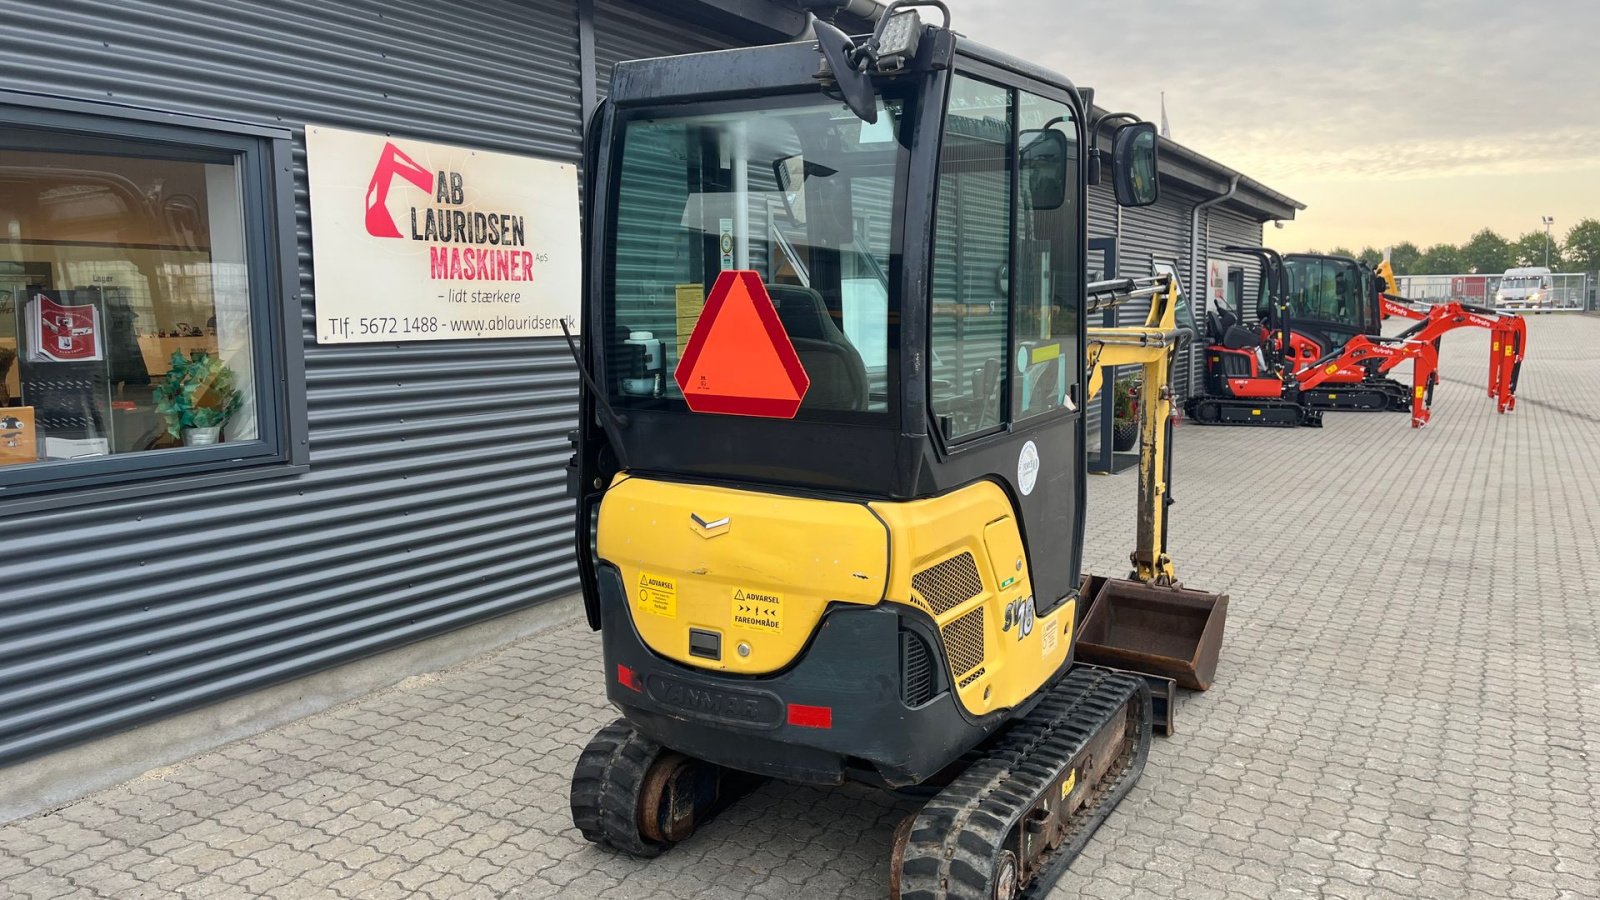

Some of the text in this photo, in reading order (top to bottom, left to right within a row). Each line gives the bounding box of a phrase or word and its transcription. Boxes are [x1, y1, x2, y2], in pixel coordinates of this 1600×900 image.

[437, 170, 464, 205] AB
[411, 206, 525, 247] LAURIDSEN
[430, 246, 549, 281] MASKINER ApS
[448, 288, 468, 303] lidt
[471, 289, 521, 303] stærkere
[1384, 302, 1408, 317] Kubota
[328, 317, 354, 339] Tlf.
[360, 317, 398, 335] 5672
[403, 316, 438, 333] 1488
[648, 578, 674, 590] ADVARSEL
[746, 593, 780, 604] ADVARSEL
[734, 615, 780, 629] FAREOMRÅDE
